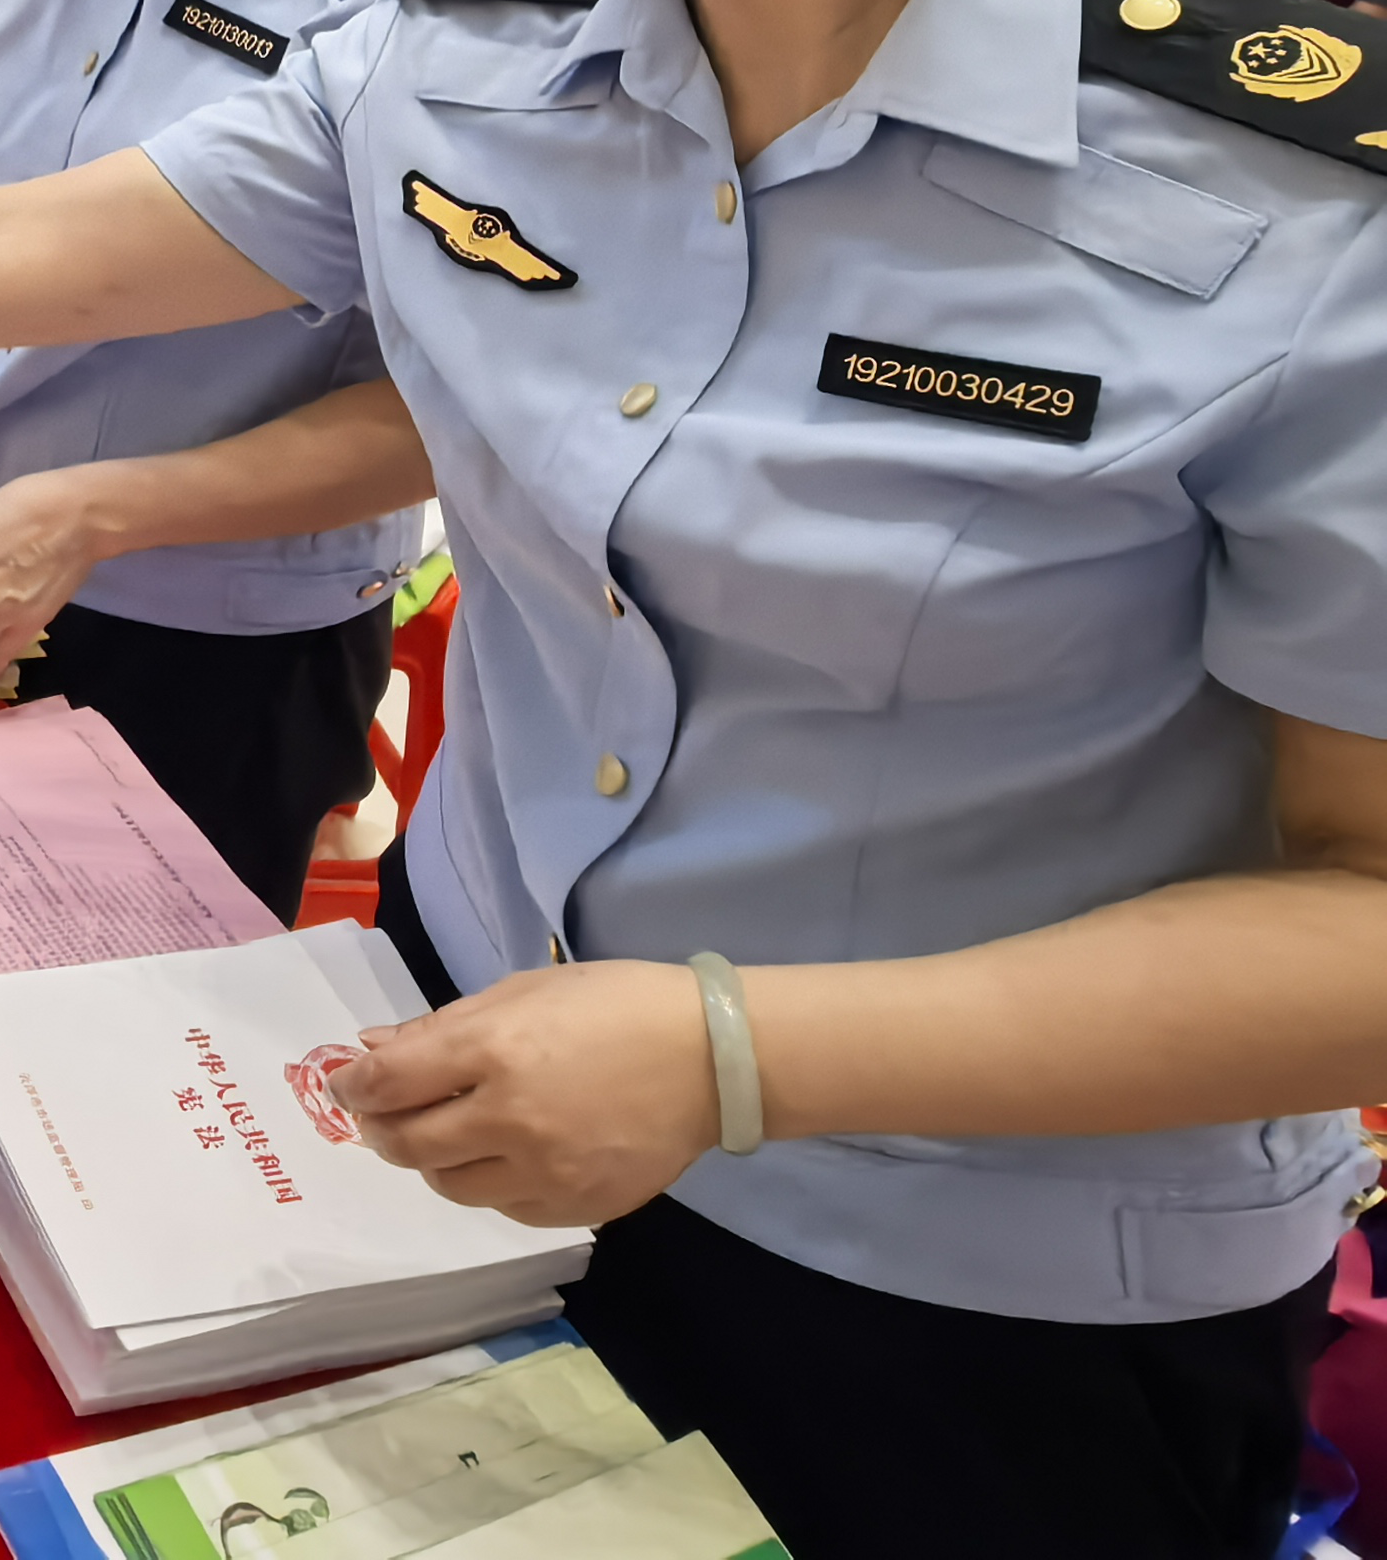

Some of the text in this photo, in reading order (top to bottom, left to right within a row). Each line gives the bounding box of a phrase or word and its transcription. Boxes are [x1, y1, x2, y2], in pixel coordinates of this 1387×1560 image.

[182, 5, 274, 59] 19210130013
[843, 352, 1076, 418] 19210030429
[171, 1086, 226, 1151] 宪法
[184, 1026, 304, 1206] 中华人民共和国
